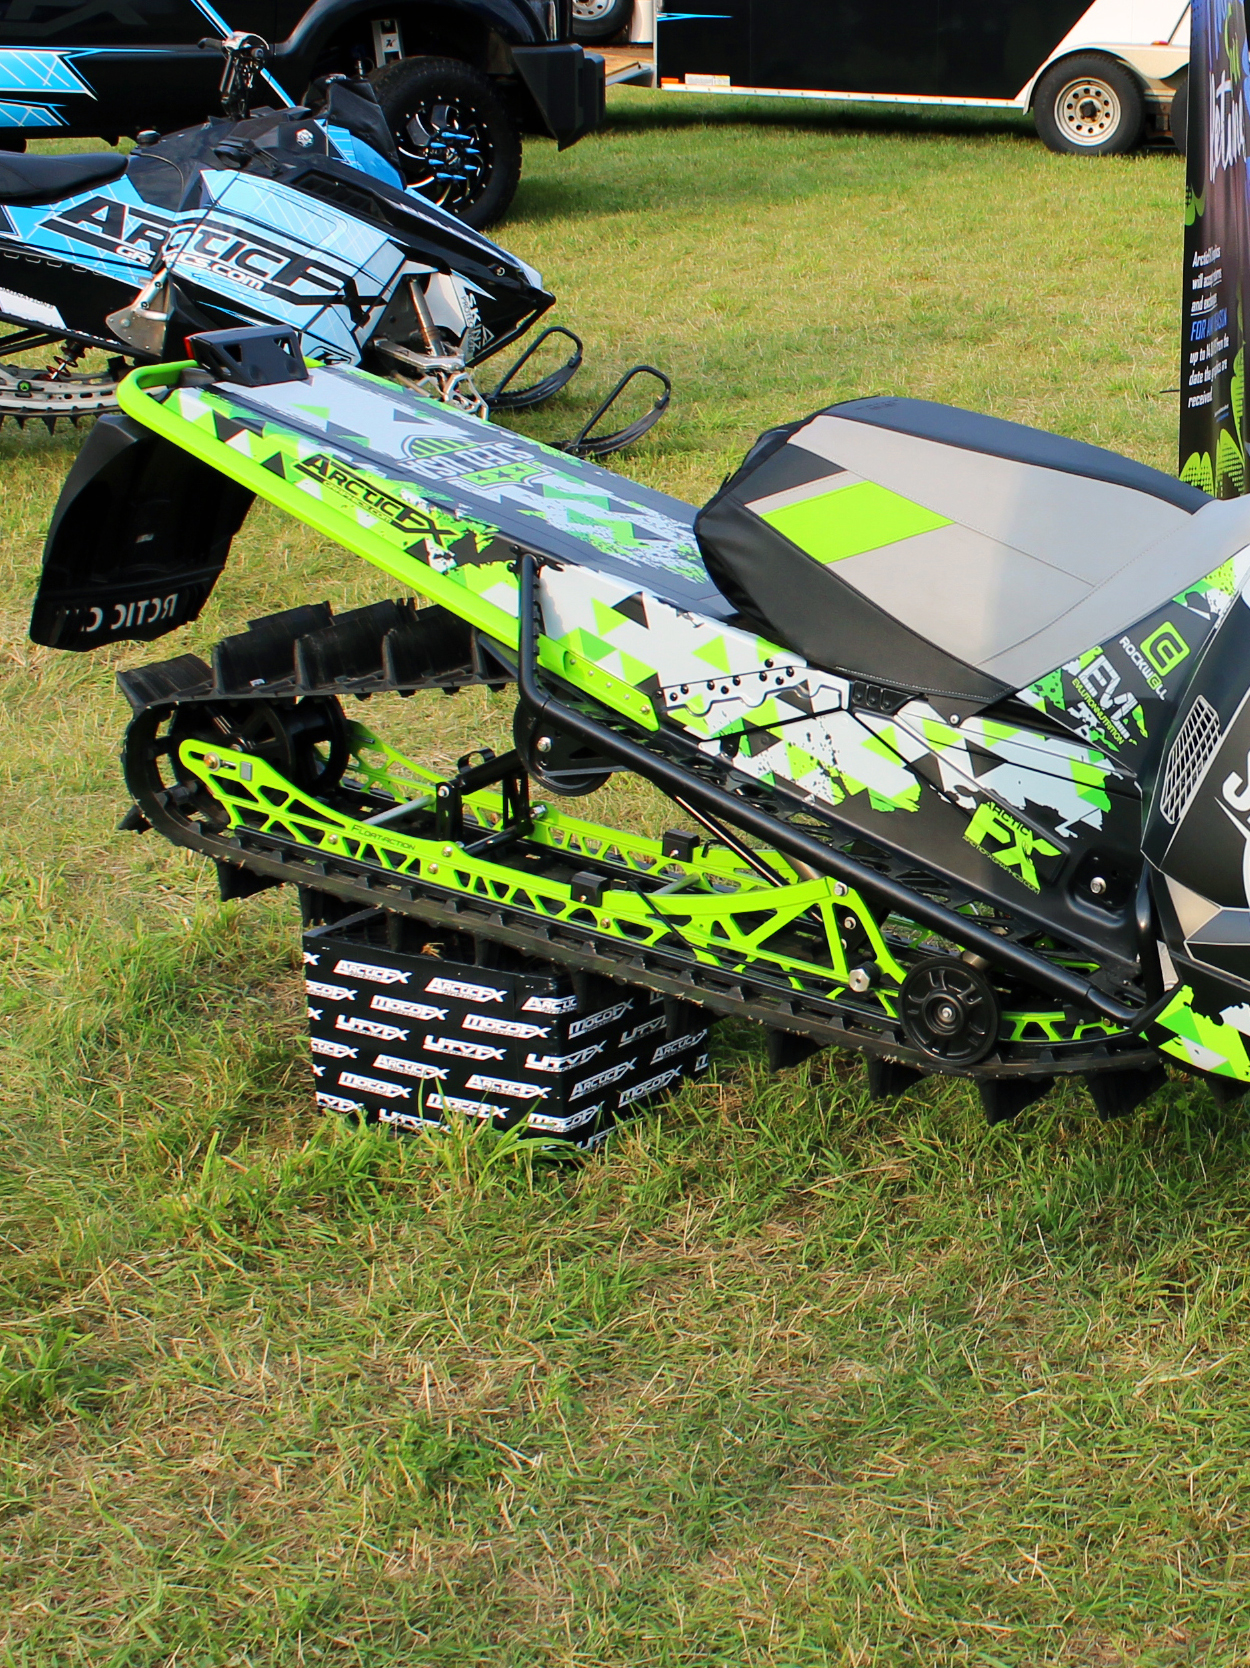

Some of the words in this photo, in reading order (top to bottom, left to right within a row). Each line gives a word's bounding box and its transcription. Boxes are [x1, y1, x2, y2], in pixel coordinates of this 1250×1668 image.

[1191, 319, 1206, 341] FOR
[1119, 636, 1168, 700] ROCKWELL
[964, 802, 1062, 890] FX
